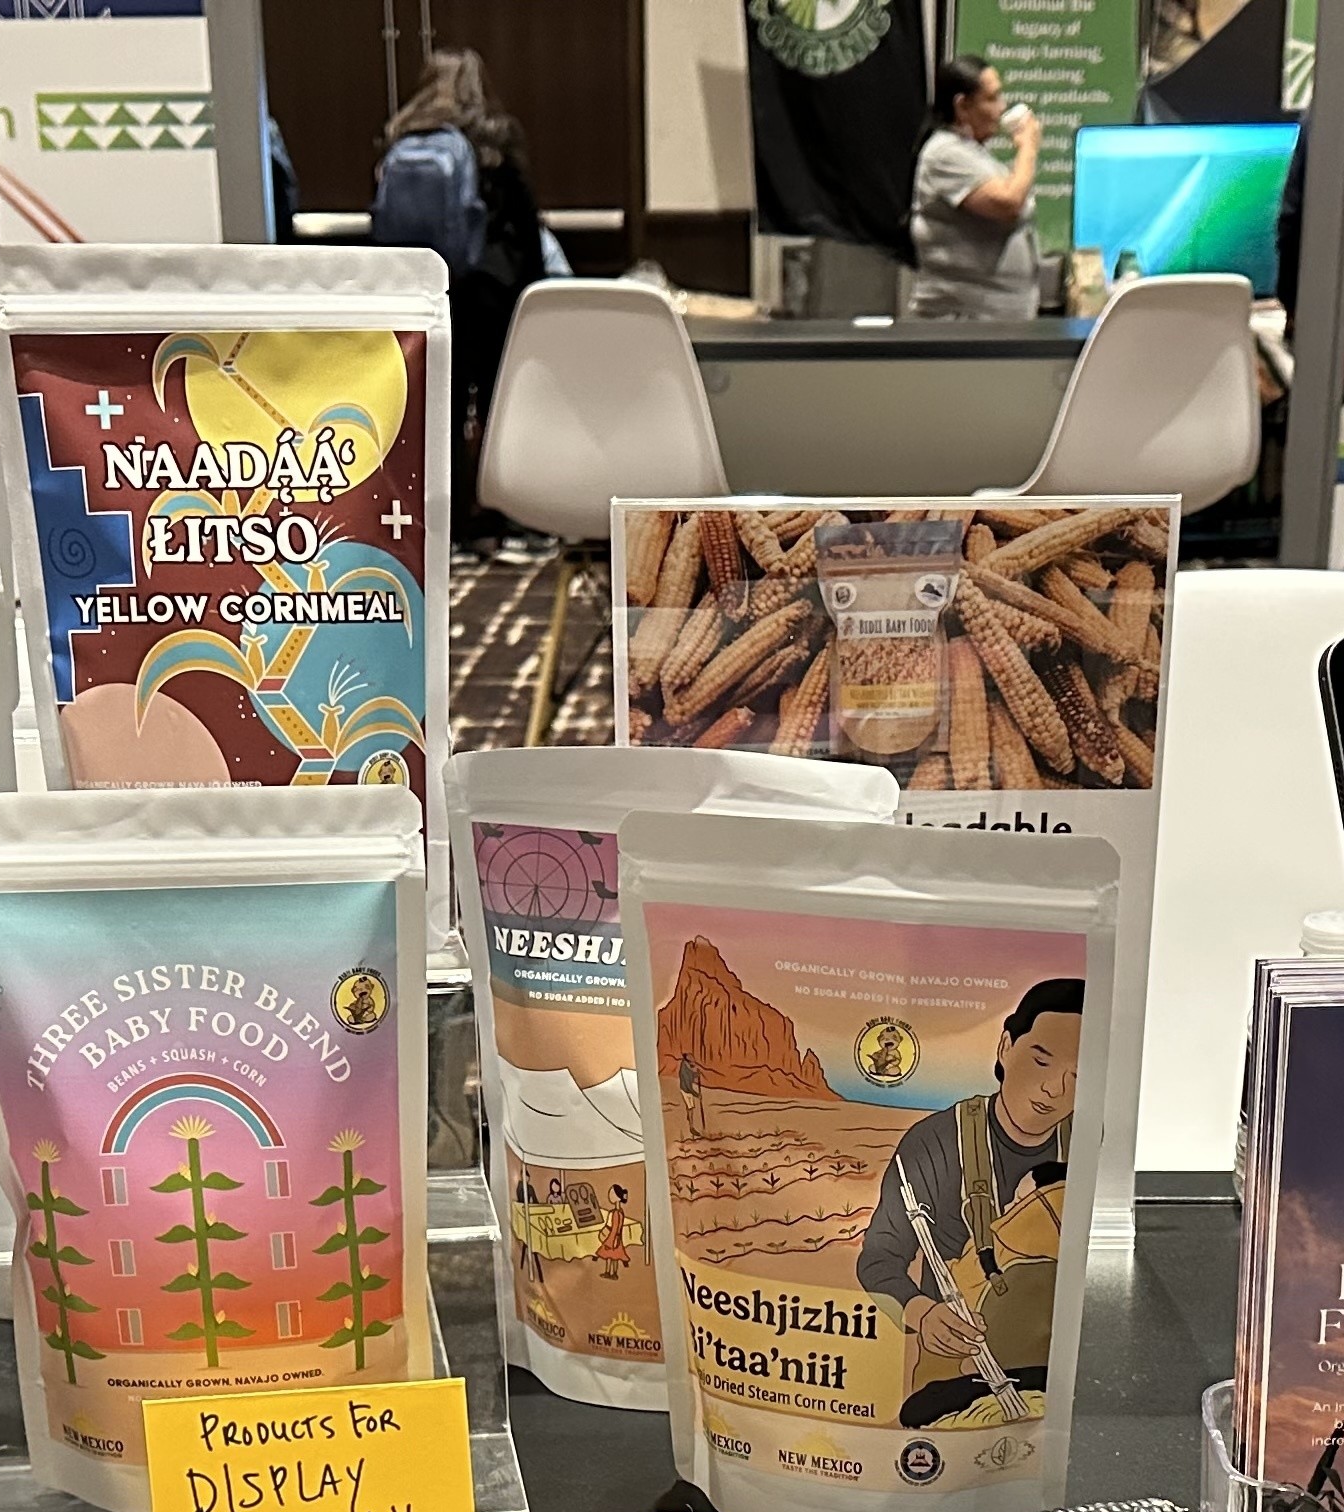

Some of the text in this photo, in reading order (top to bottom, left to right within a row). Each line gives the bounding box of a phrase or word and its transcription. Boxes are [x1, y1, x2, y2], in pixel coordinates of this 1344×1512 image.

[76, 592, 402, 623] YELLOW CORNMEAL
[886, 619, 906, 633] BABY
[494, 926, 627, 966] NEESHJ
[514, 969, 582, 983] ORGANICALLY
[775, 960, 855, 978] ORGANICALLY
[911, 976, 959, 986] NAVAJO
[27, 964, 351, 1092] THREE SISTER BLEND
[79, 1007, 289, 1069] BABY FOOD
[107, 1059, 147, 1093] BEANS
[161, 1048, 216, 1062] SQUASH
[233, 1060, 267, 1087] CORN
[681, 1267, 878, 1340] Neeshjizhii
[588, 1333, 661, 1351] NEW MEXICO
[107, 1378, 182, 1388] ORGANICALLY
[235, 1374, 278, 1386] NAVAJO
[714, 1375, 744, 1396] Dried
[749, 1385, 790, 1405] Steam
[795, 1394, 825, 1411] Corn
[830, 1400, 875, 1418] Cereal
[1313, 1402, 1330, 1412] An
[779, 1450, 862, 1475] NEW MEXICO
